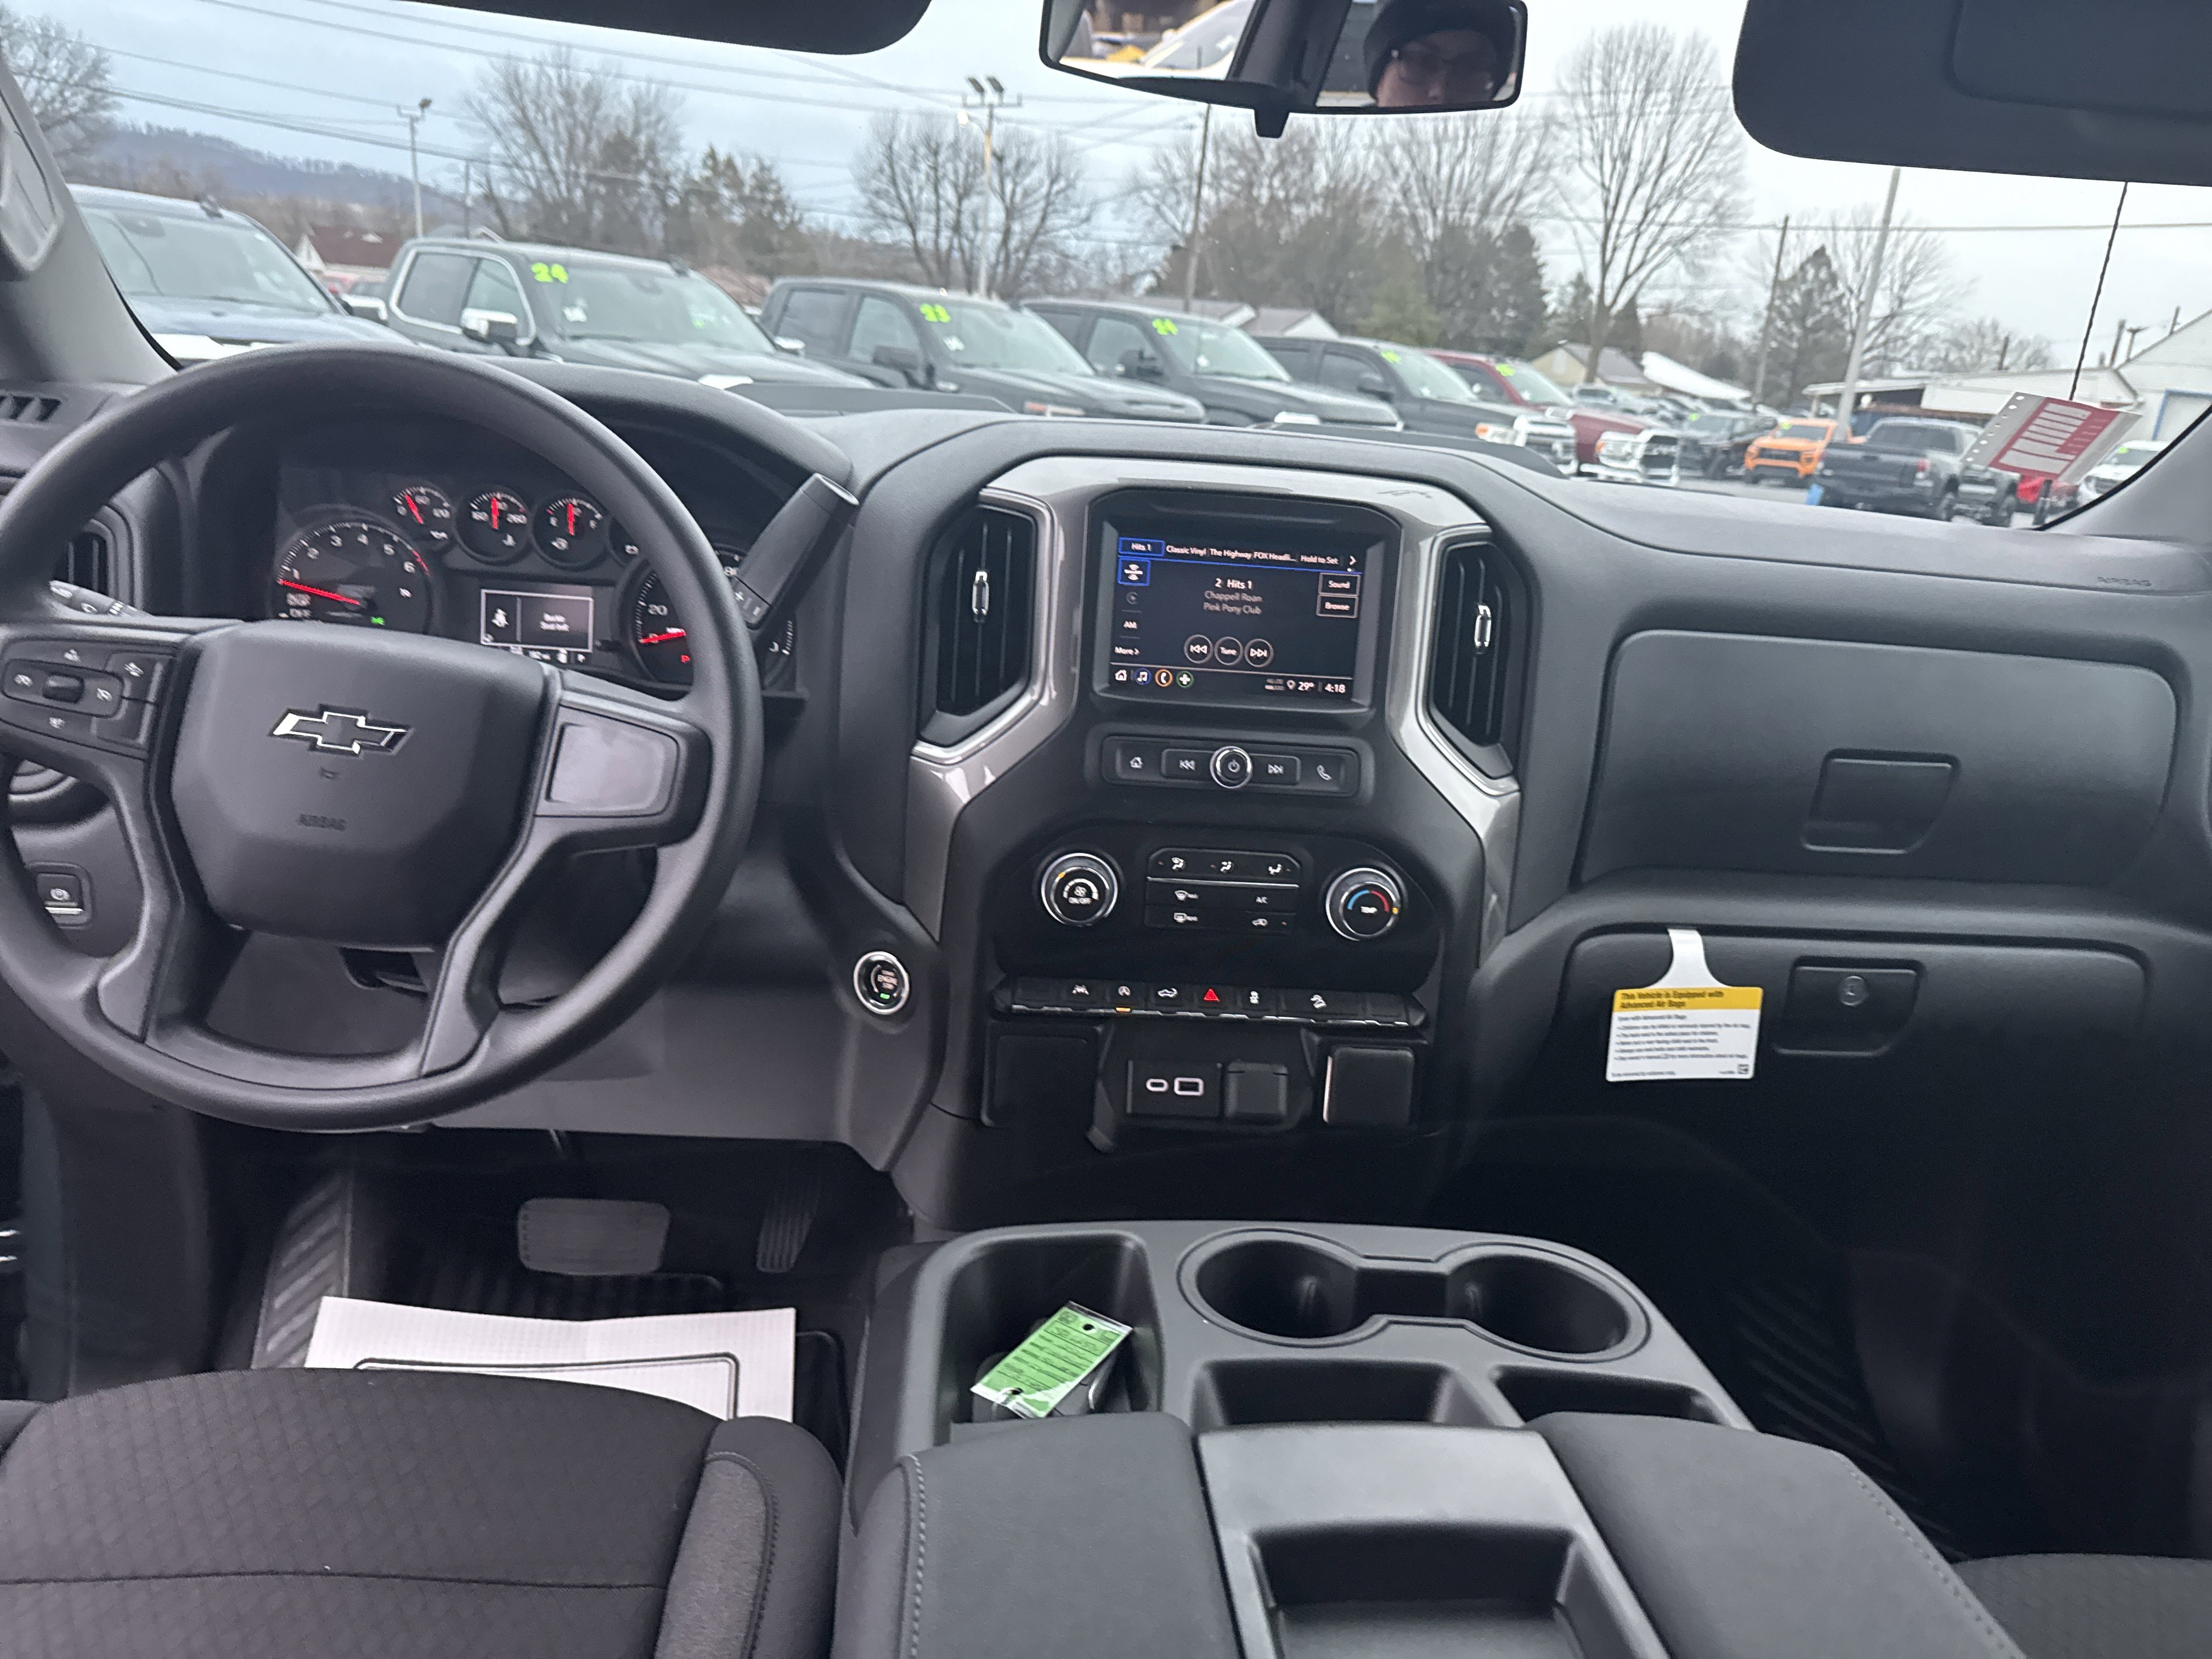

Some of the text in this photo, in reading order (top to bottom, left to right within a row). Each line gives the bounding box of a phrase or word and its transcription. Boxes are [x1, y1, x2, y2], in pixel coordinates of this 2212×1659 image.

[531, 262, 569, 284] 24
[330, 535, 343, 548] 3
[357, 533, 369, 545] 4
[383, 544, 395, 556] 5
[1131, 543, 1146, 551] Hits
[1166, 545, 1207, 556] Classic Vinyl
[307, 548, 319, 560] 2
[1223, 549, 1252, 560] Highway
[1254, 551, 1268, 560] FOX
[1301, 555, 1317, 563] Hold
[1326, 556, 1340, 565] Set
[403, 561, 416, 574] 6
[1215, 578, 1252, 589] 2 Hits 1
[1328, 579, 1350, 589] Sound
[1204, 590, 1263, 602] Chappell Roan
[648, 604, 668, 616] 20
[1203, 602, 1262, 615] Pink Pony Club
[1324, 602, 1350, 611] Browse
[1123, 620, 1137, 630] AM
[1114, 646, 1134, 656] More
[1220, 647, 1237, 656] Tune
[681, 654, 690, 663] P
[1324, 683, 1346, 693] 4:18
[1621, 992, 1635, 1000] This
[1637, 991, 1663, 999] Vehicle
